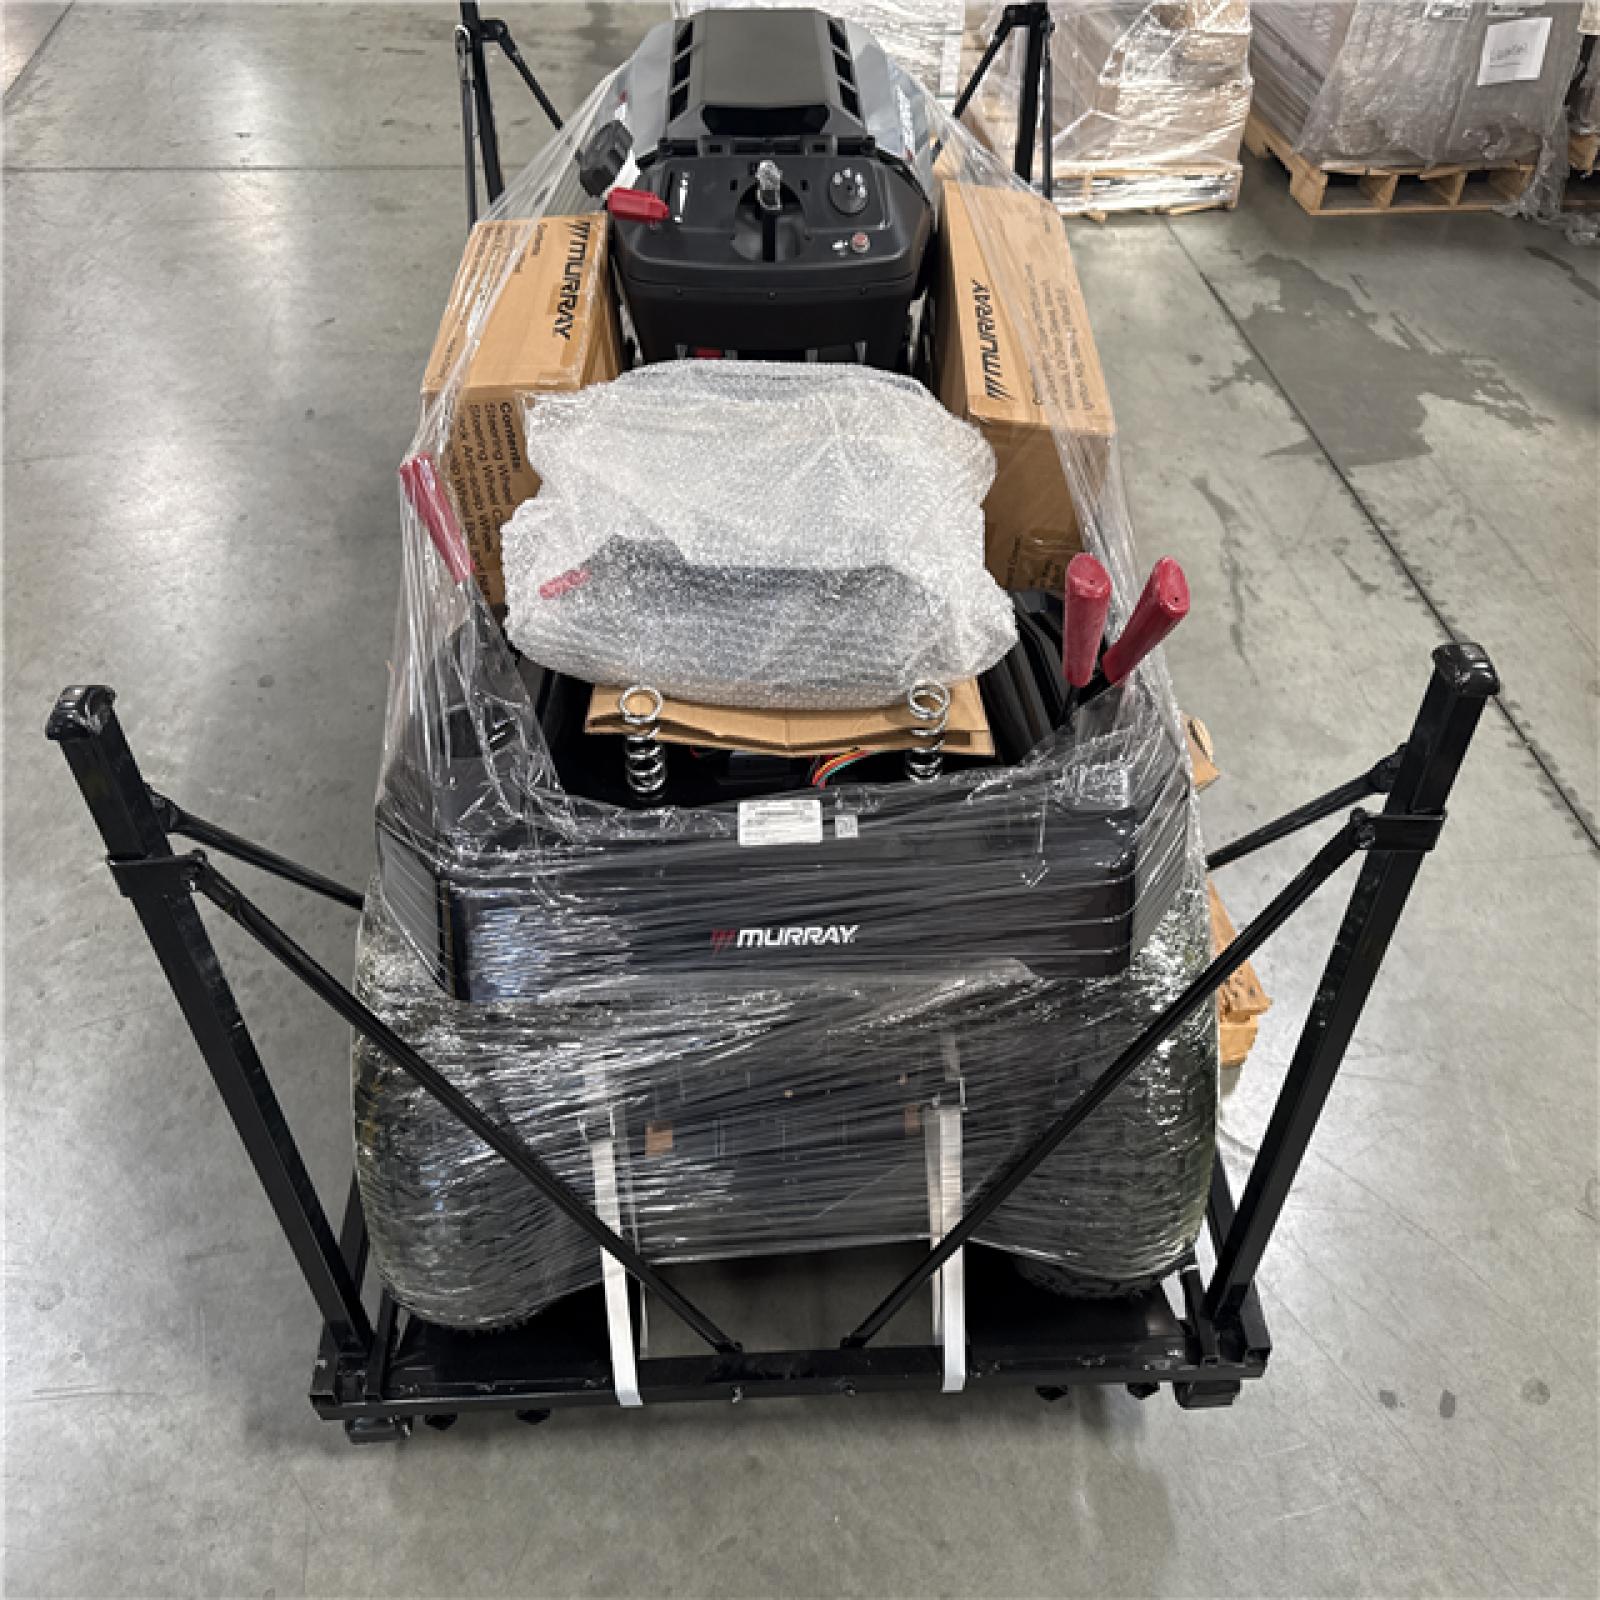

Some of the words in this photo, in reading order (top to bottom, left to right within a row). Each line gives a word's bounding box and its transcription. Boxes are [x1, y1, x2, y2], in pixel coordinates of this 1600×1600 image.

[553, 239, 586, 341] MURRAY
[970, 277, 1001, 377] MURRAY
[736, 924, 861, 948] MURRAY
